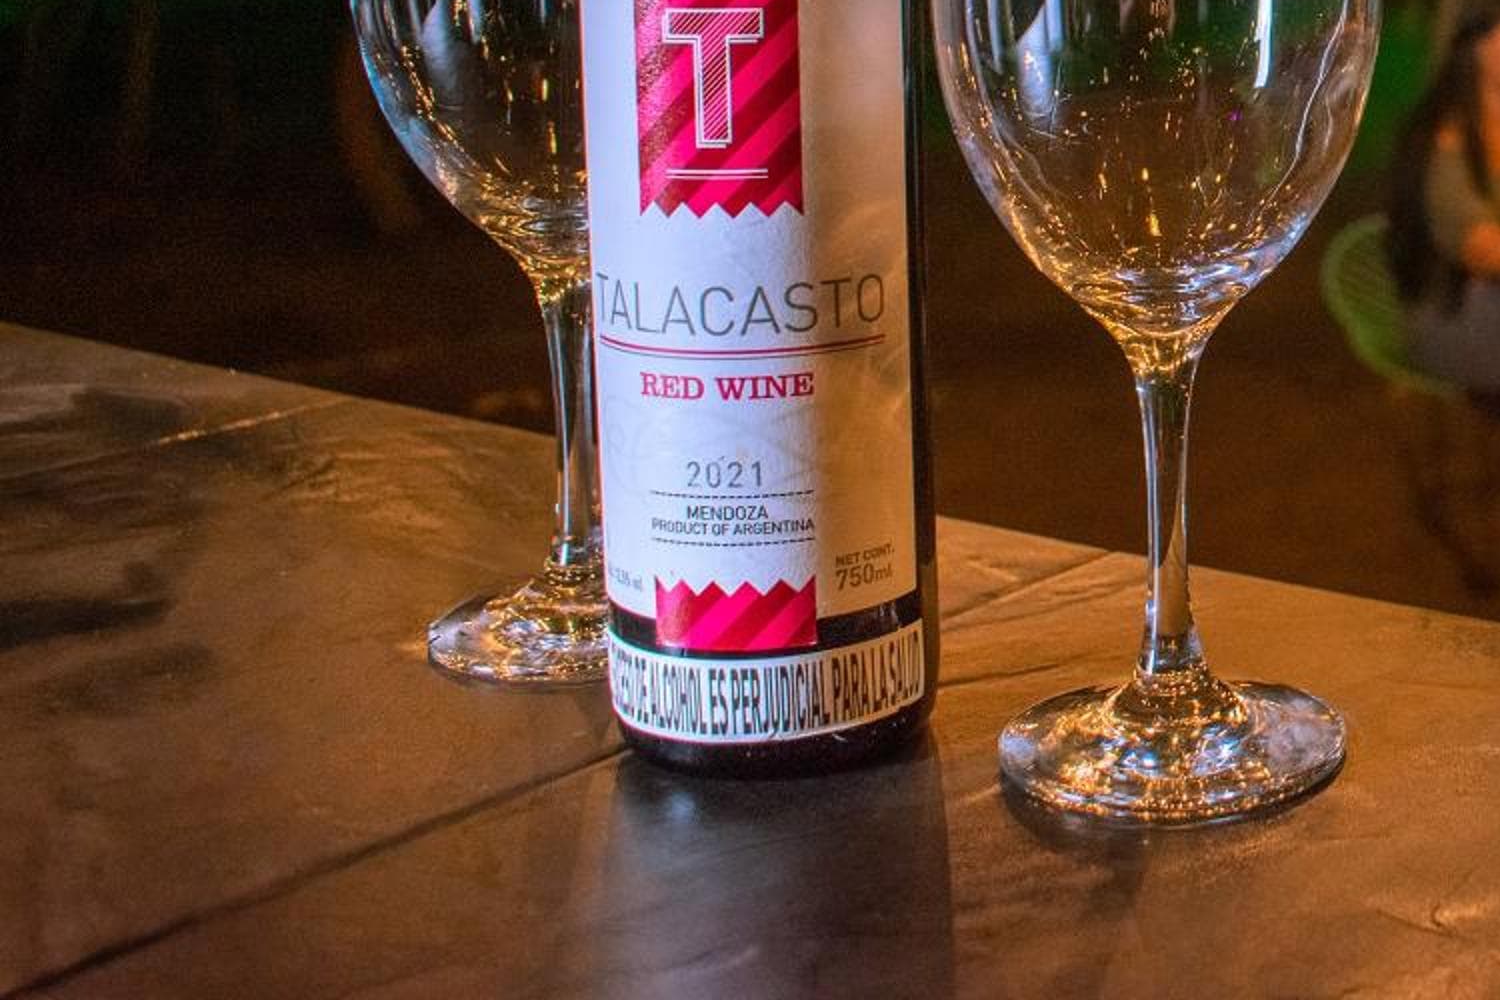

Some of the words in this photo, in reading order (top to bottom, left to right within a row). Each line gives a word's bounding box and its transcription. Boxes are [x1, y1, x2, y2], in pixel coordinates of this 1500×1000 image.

[661, 8, 764, 149] T
[596, 273, 884, 337] TALACASTO
[640, 372, 705, 399] RED
[715, 372, 814, 401] WINE
[687, 461, 763, 488] 2021
[651, 517, 707, 535] PRODUCT
[711, 523, 730, 536] OF
[733, 518, 815, 536] ARGENTINA
[686, 505, 769, 521] MENDOZA
[835, 551, 861, 568] NET
[651, 660, 707, 735] ALCOHOL
[708, 668, 728, 735] ES
[730, 660, 831, 735] PERJUDICIAL
[831, 650, 870, 724] PARA
[871, 645, 888, 713] LA
